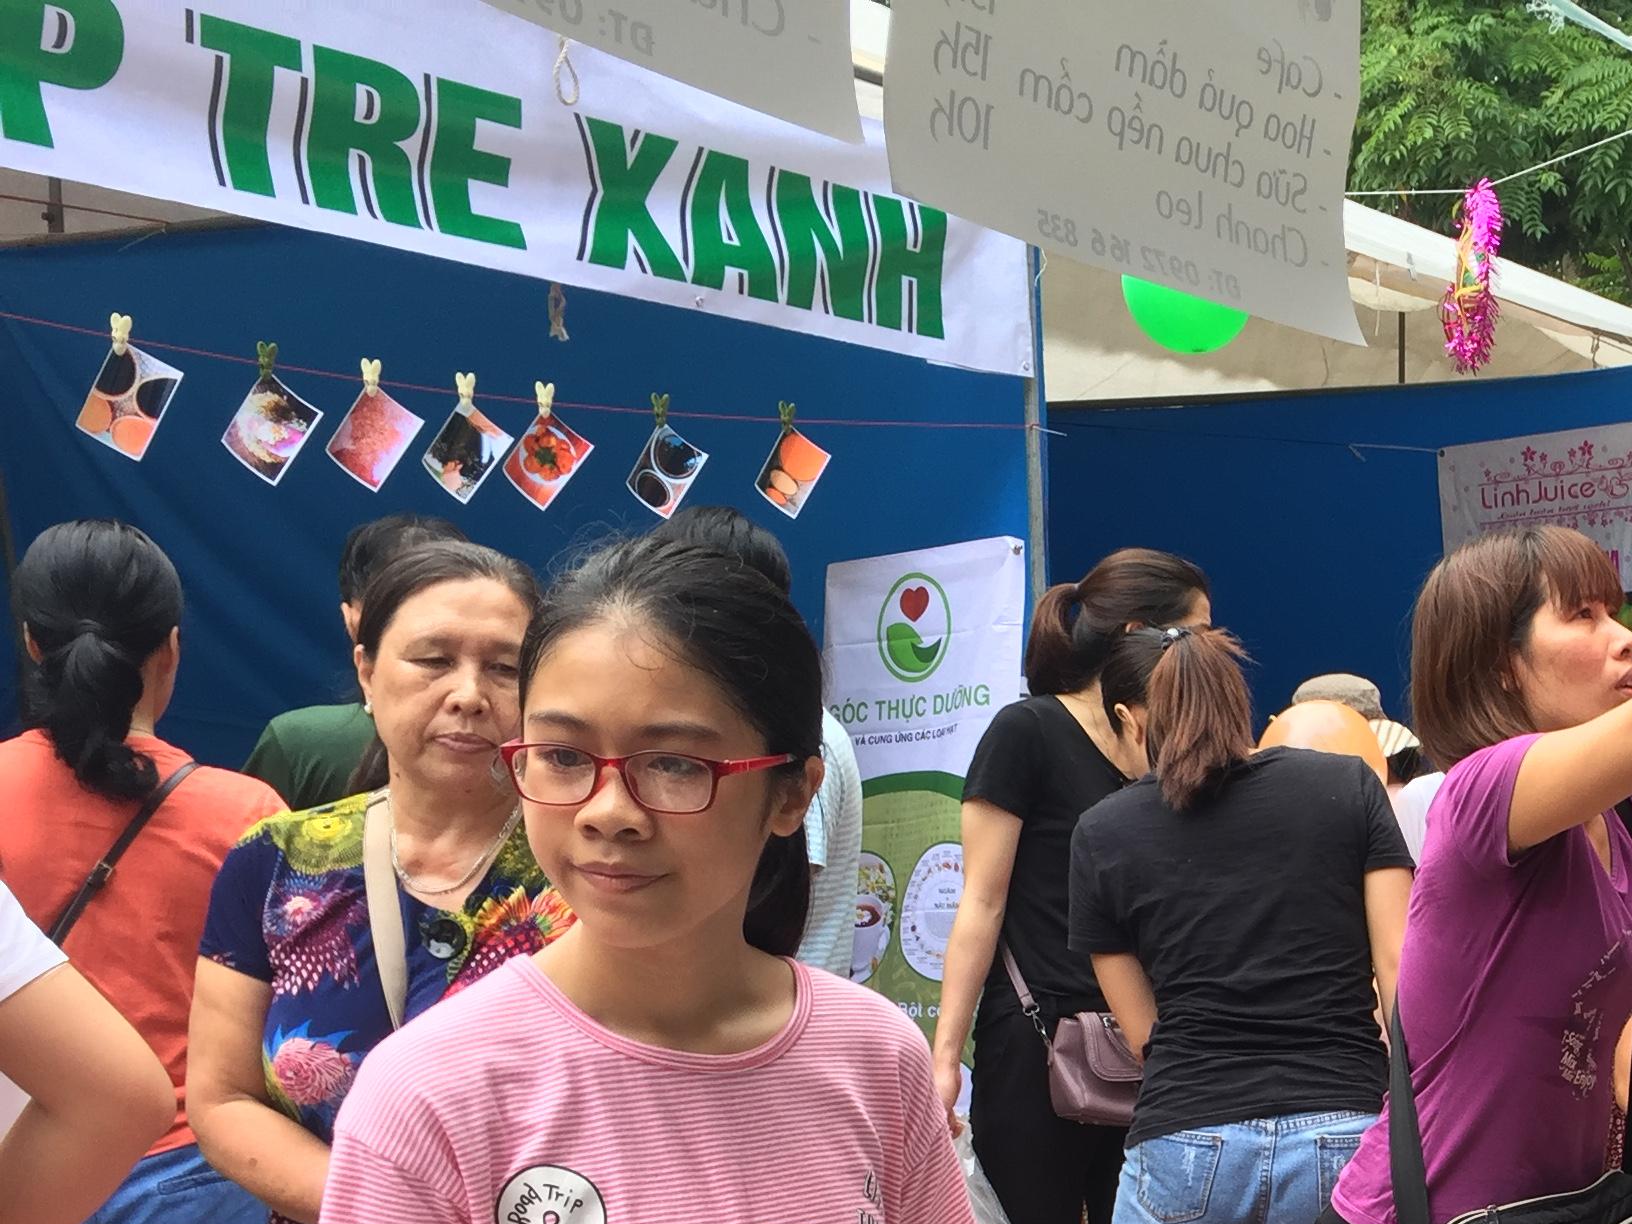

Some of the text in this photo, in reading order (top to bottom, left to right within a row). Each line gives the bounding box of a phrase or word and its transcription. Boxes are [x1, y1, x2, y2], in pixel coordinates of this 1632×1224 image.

[200, 9, 526, 250] TRE
[575, 112, 947, 340] XANH
[875, 695, 926, 724] THỰC
[933, 683, 990, 715] DƯỠNG
[868, 733, 892, 745] CUNG
[915, 729, 931, 741] CÁC
[543, 1183, 584, 1214] Trip
